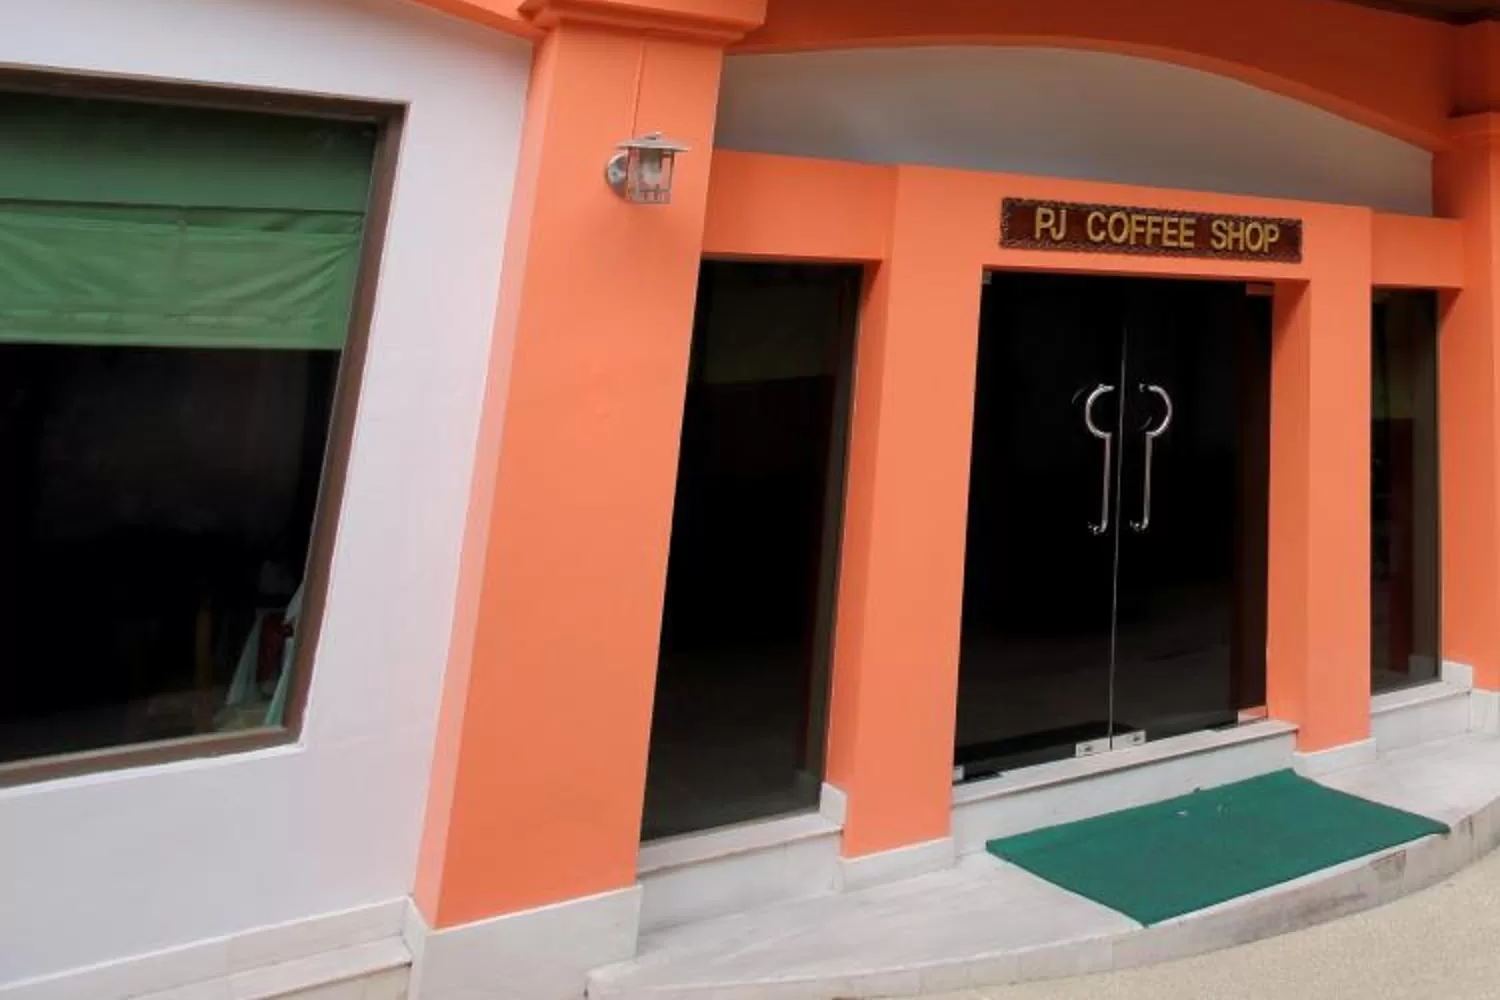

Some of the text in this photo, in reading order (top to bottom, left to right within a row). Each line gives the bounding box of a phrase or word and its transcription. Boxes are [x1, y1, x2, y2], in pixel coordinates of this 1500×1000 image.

[1035, 207, 1279, 252] PJ COFFEE SHOP
